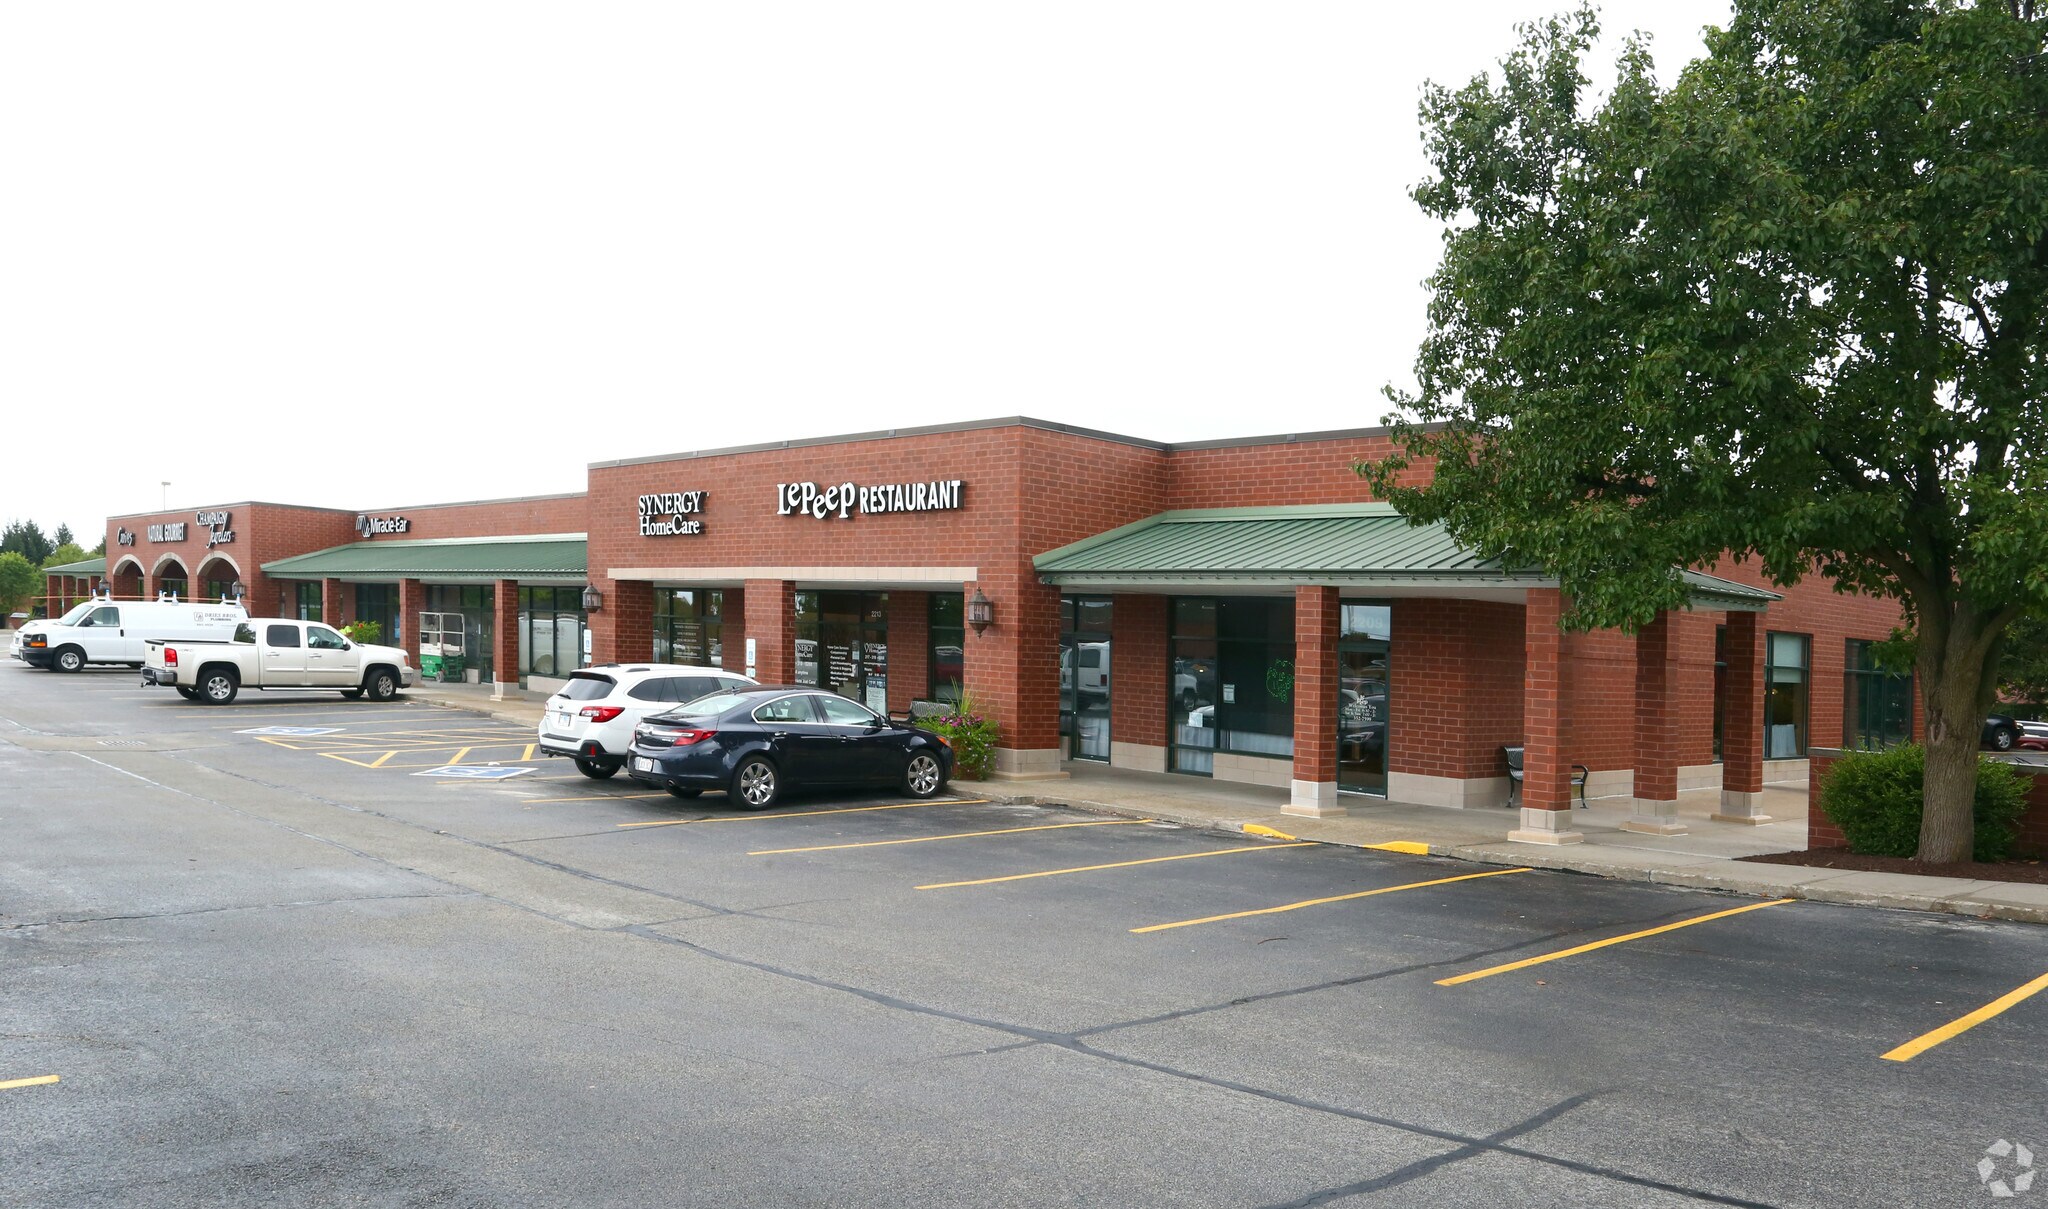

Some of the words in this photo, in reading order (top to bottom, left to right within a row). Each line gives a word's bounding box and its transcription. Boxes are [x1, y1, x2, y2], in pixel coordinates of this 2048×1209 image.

[638, 491, 701, 515] SYNERGY
[859, 480, 961, 514] RESTAURANT
[370, 516, 408, 533] Miracle-Ear
[639, 514, 700, 536] HomeCare
[1350, 615, 1383, 629] 2209
